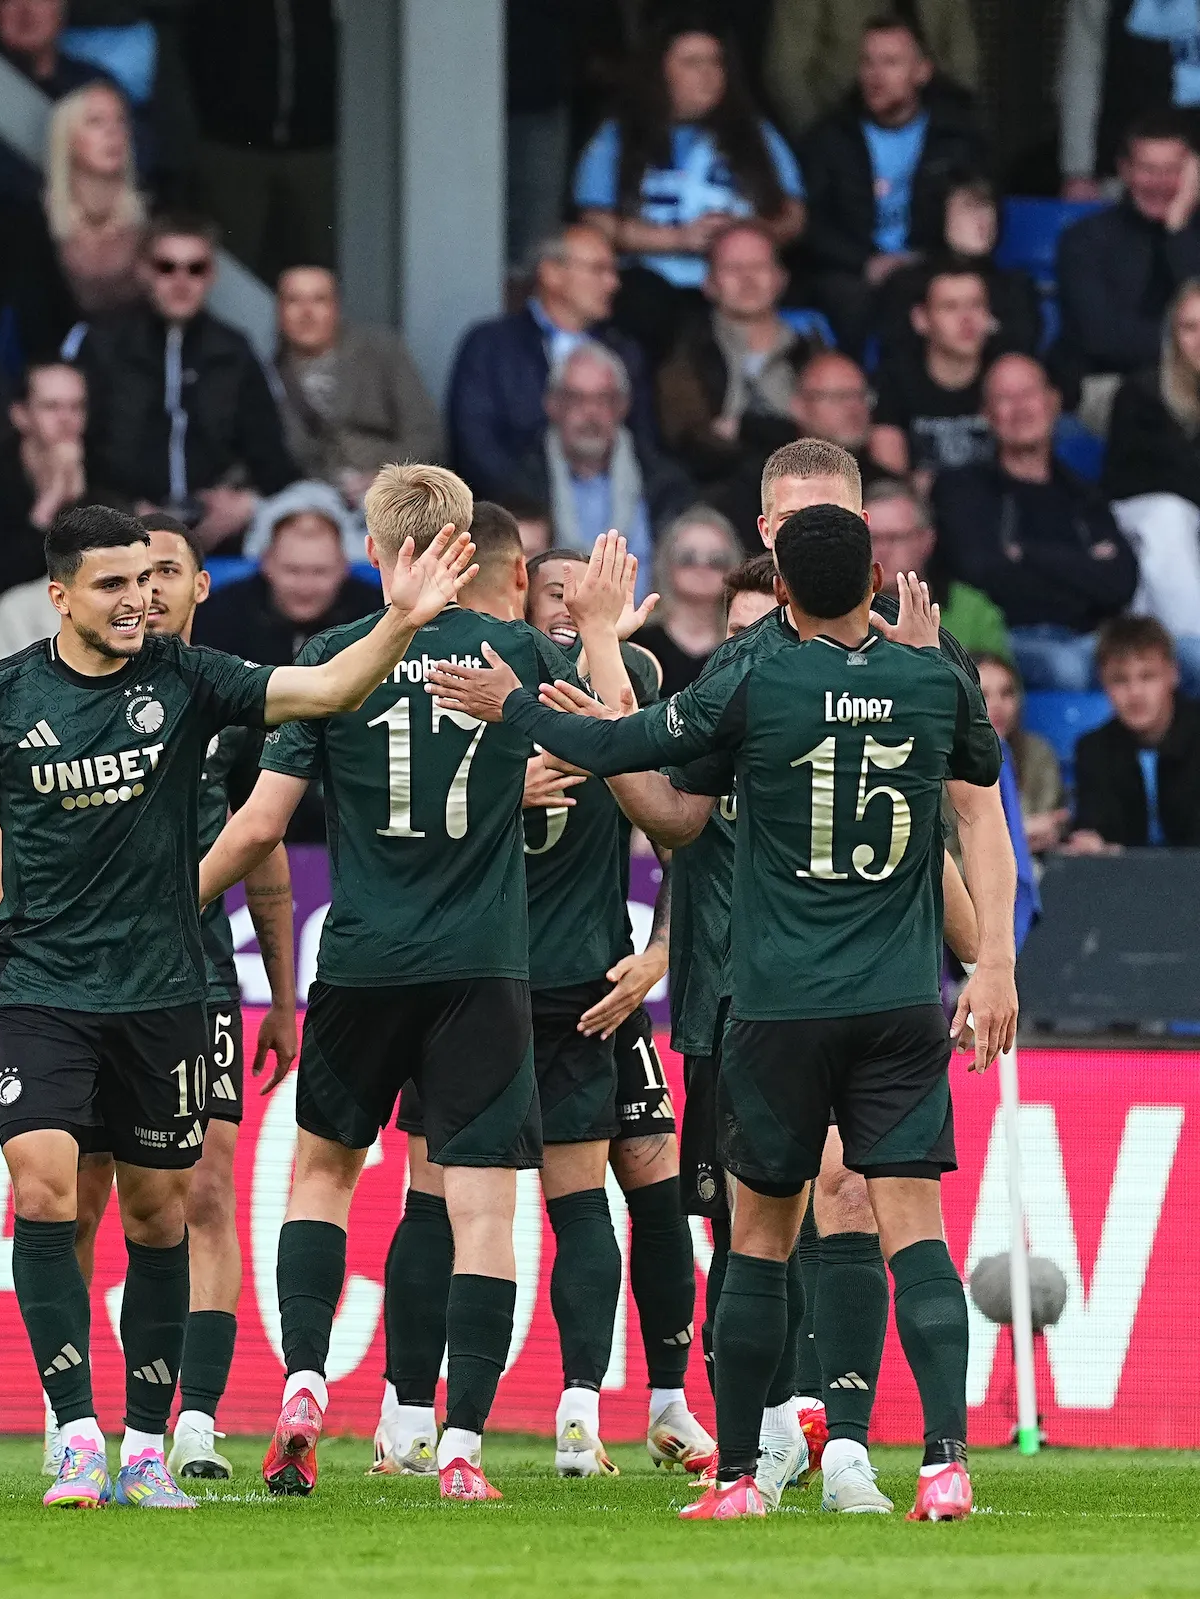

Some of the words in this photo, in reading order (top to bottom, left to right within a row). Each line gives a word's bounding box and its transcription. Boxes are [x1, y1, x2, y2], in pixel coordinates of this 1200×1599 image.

[824, 690, 893, 727] López
[31, 742, 165, 794] UNIBET
[366, 696, 487, 840] 17
[789, 734, 915, 882] 15
[213, 1011, 235, 1068] 5
[170, 1054, 207, 1118] 10
[621, 1101, 648, 1114] BET
[134, 1125, 177, 1143] UNIBET
